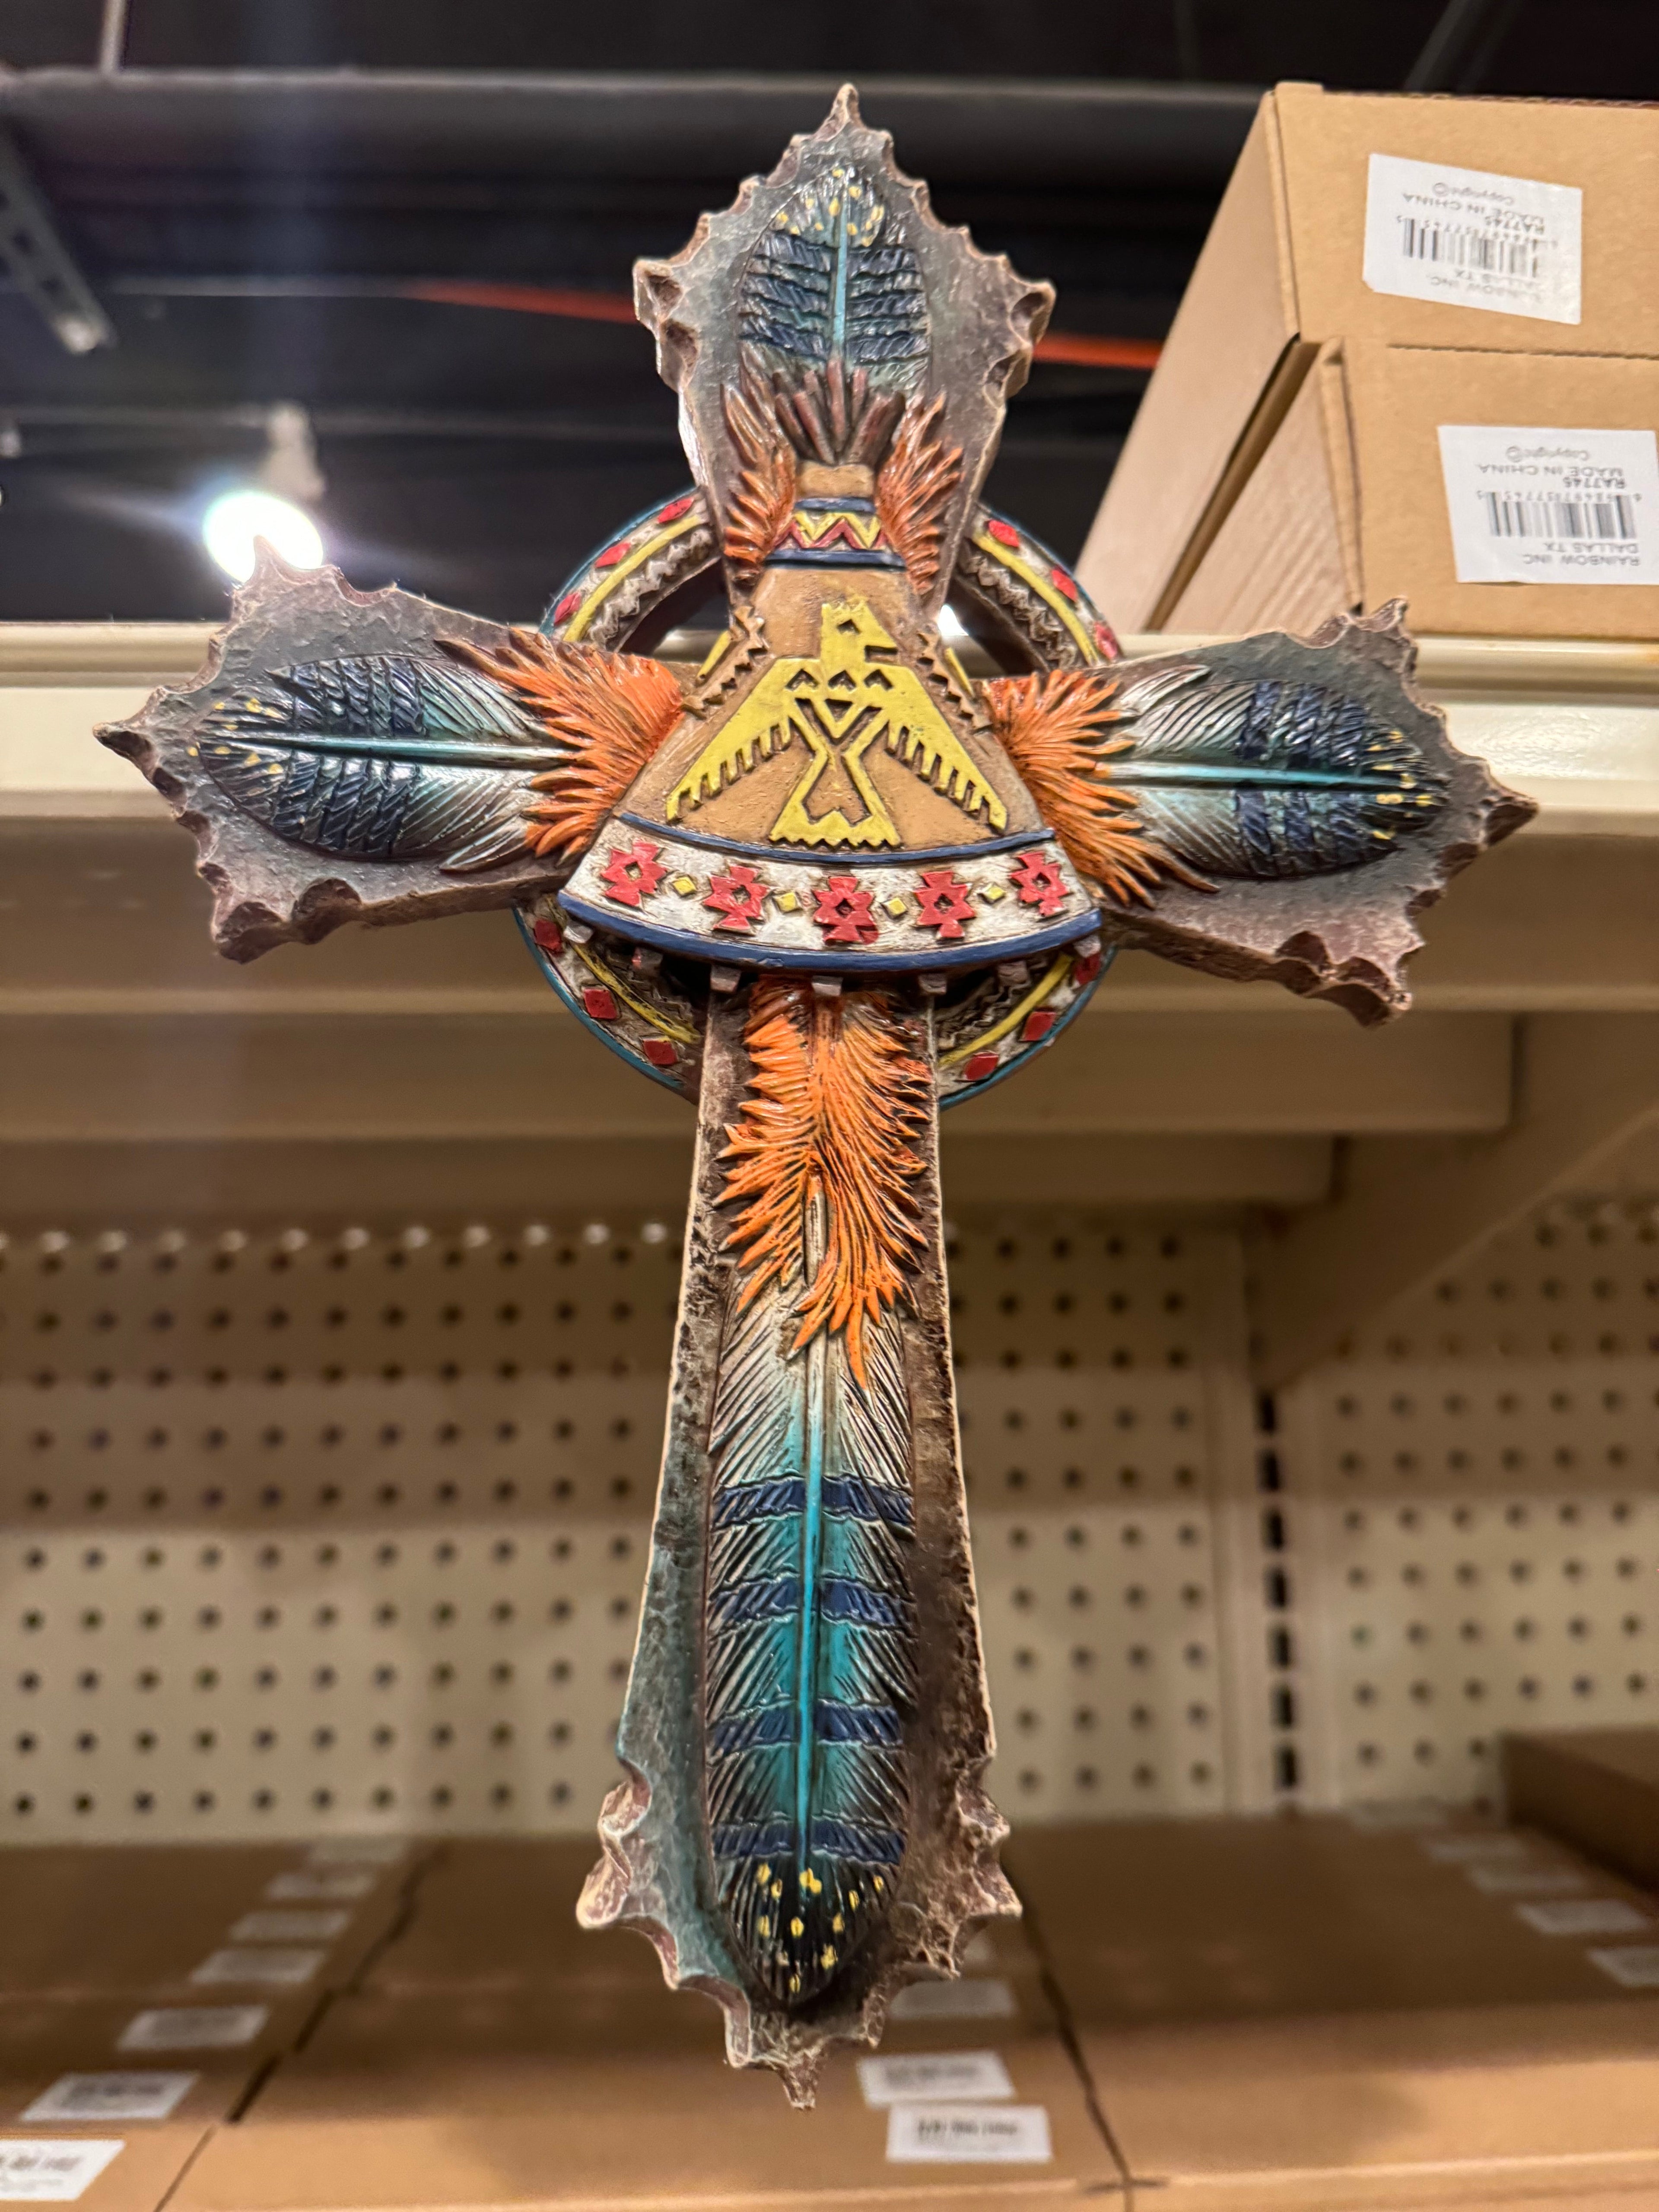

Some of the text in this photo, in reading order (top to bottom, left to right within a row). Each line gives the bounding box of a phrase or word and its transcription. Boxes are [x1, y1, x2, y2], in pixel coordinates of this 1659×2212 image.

[1402, 193, 1545, 224] MADE IN CHINA
[1485, 216, 1545, 235] RA7745
[1478, 464, 1623, 477] MADE IN CHINA
[1563, 477, 1626, 489] RA7745
[1544, 542, 1639, 553] DALLAS TX
[1562, 555, 1641, 566] RAINBOW
